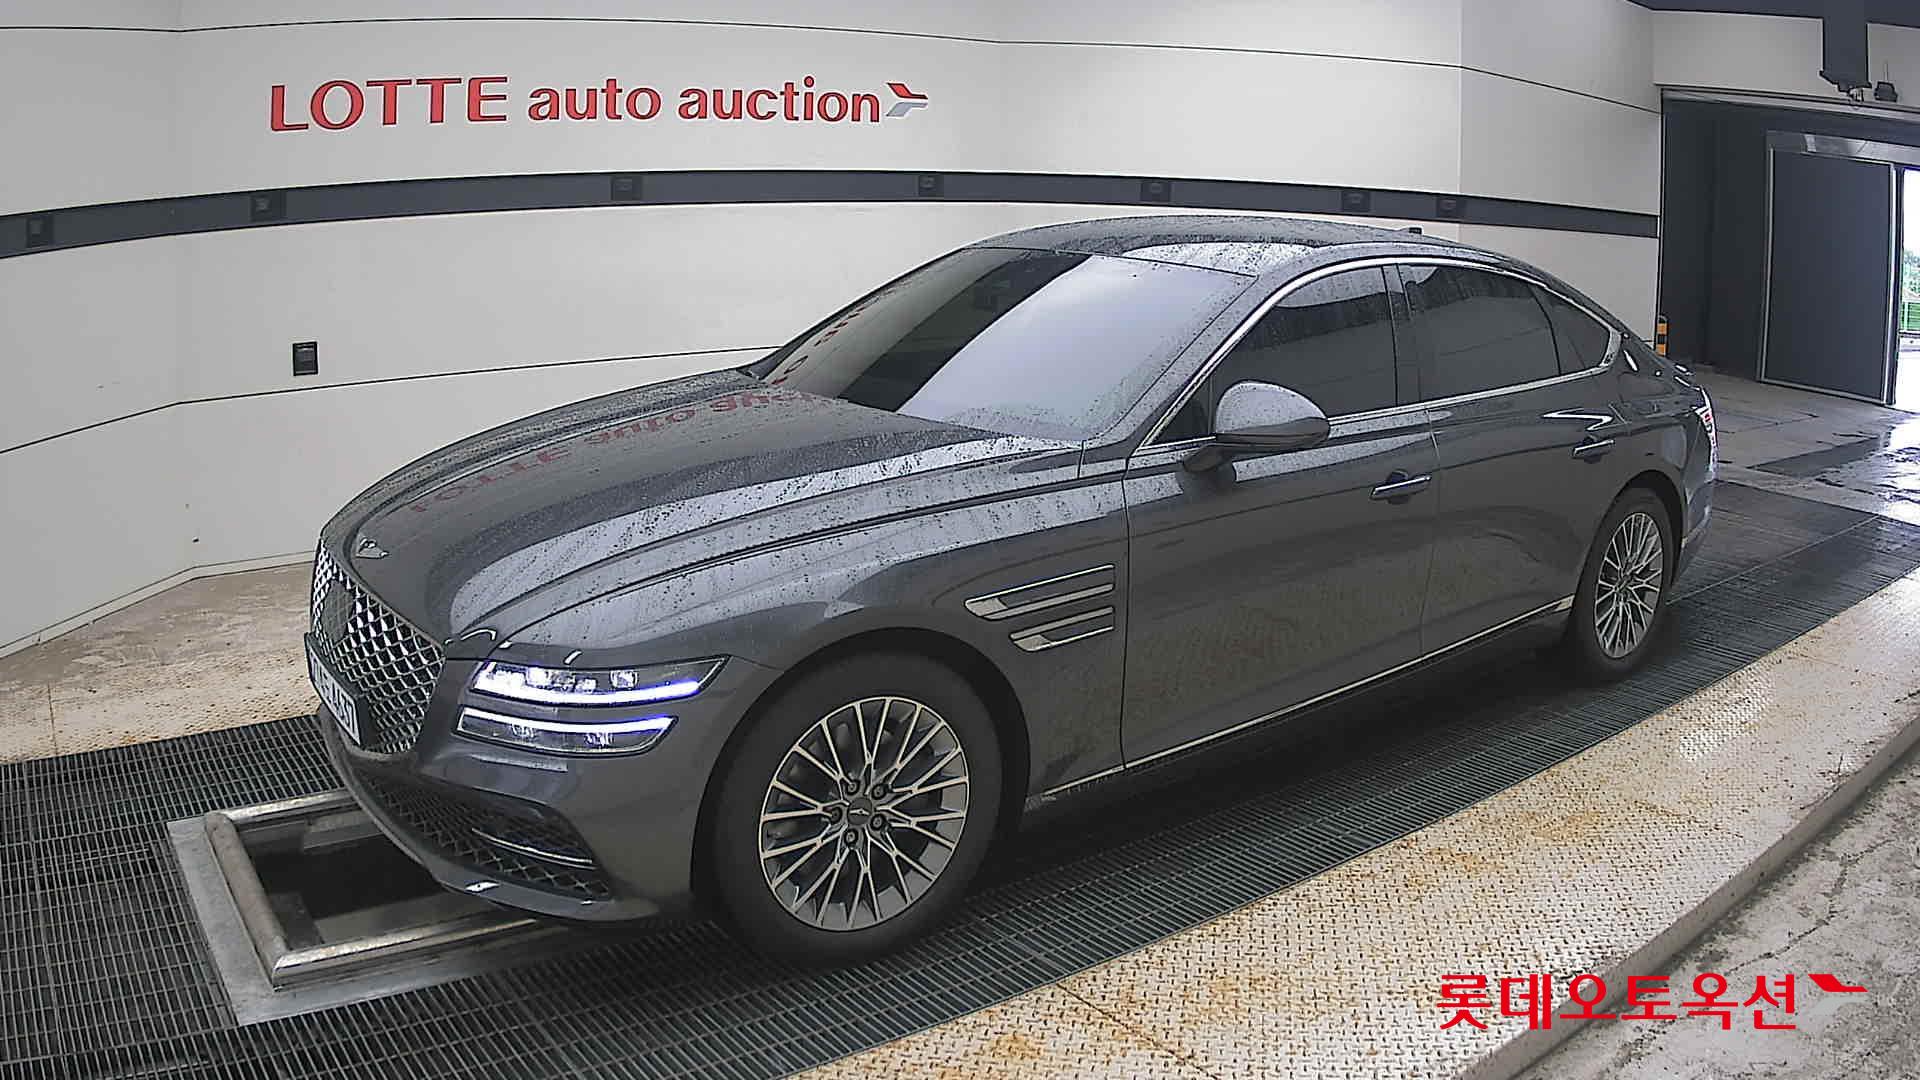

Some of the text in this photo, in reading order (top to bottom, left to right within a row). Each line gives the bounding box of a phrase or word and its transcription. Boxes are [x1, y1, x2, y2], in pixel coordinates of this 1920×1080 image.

[270, 76, 881, 132] LOTTE auto auction
